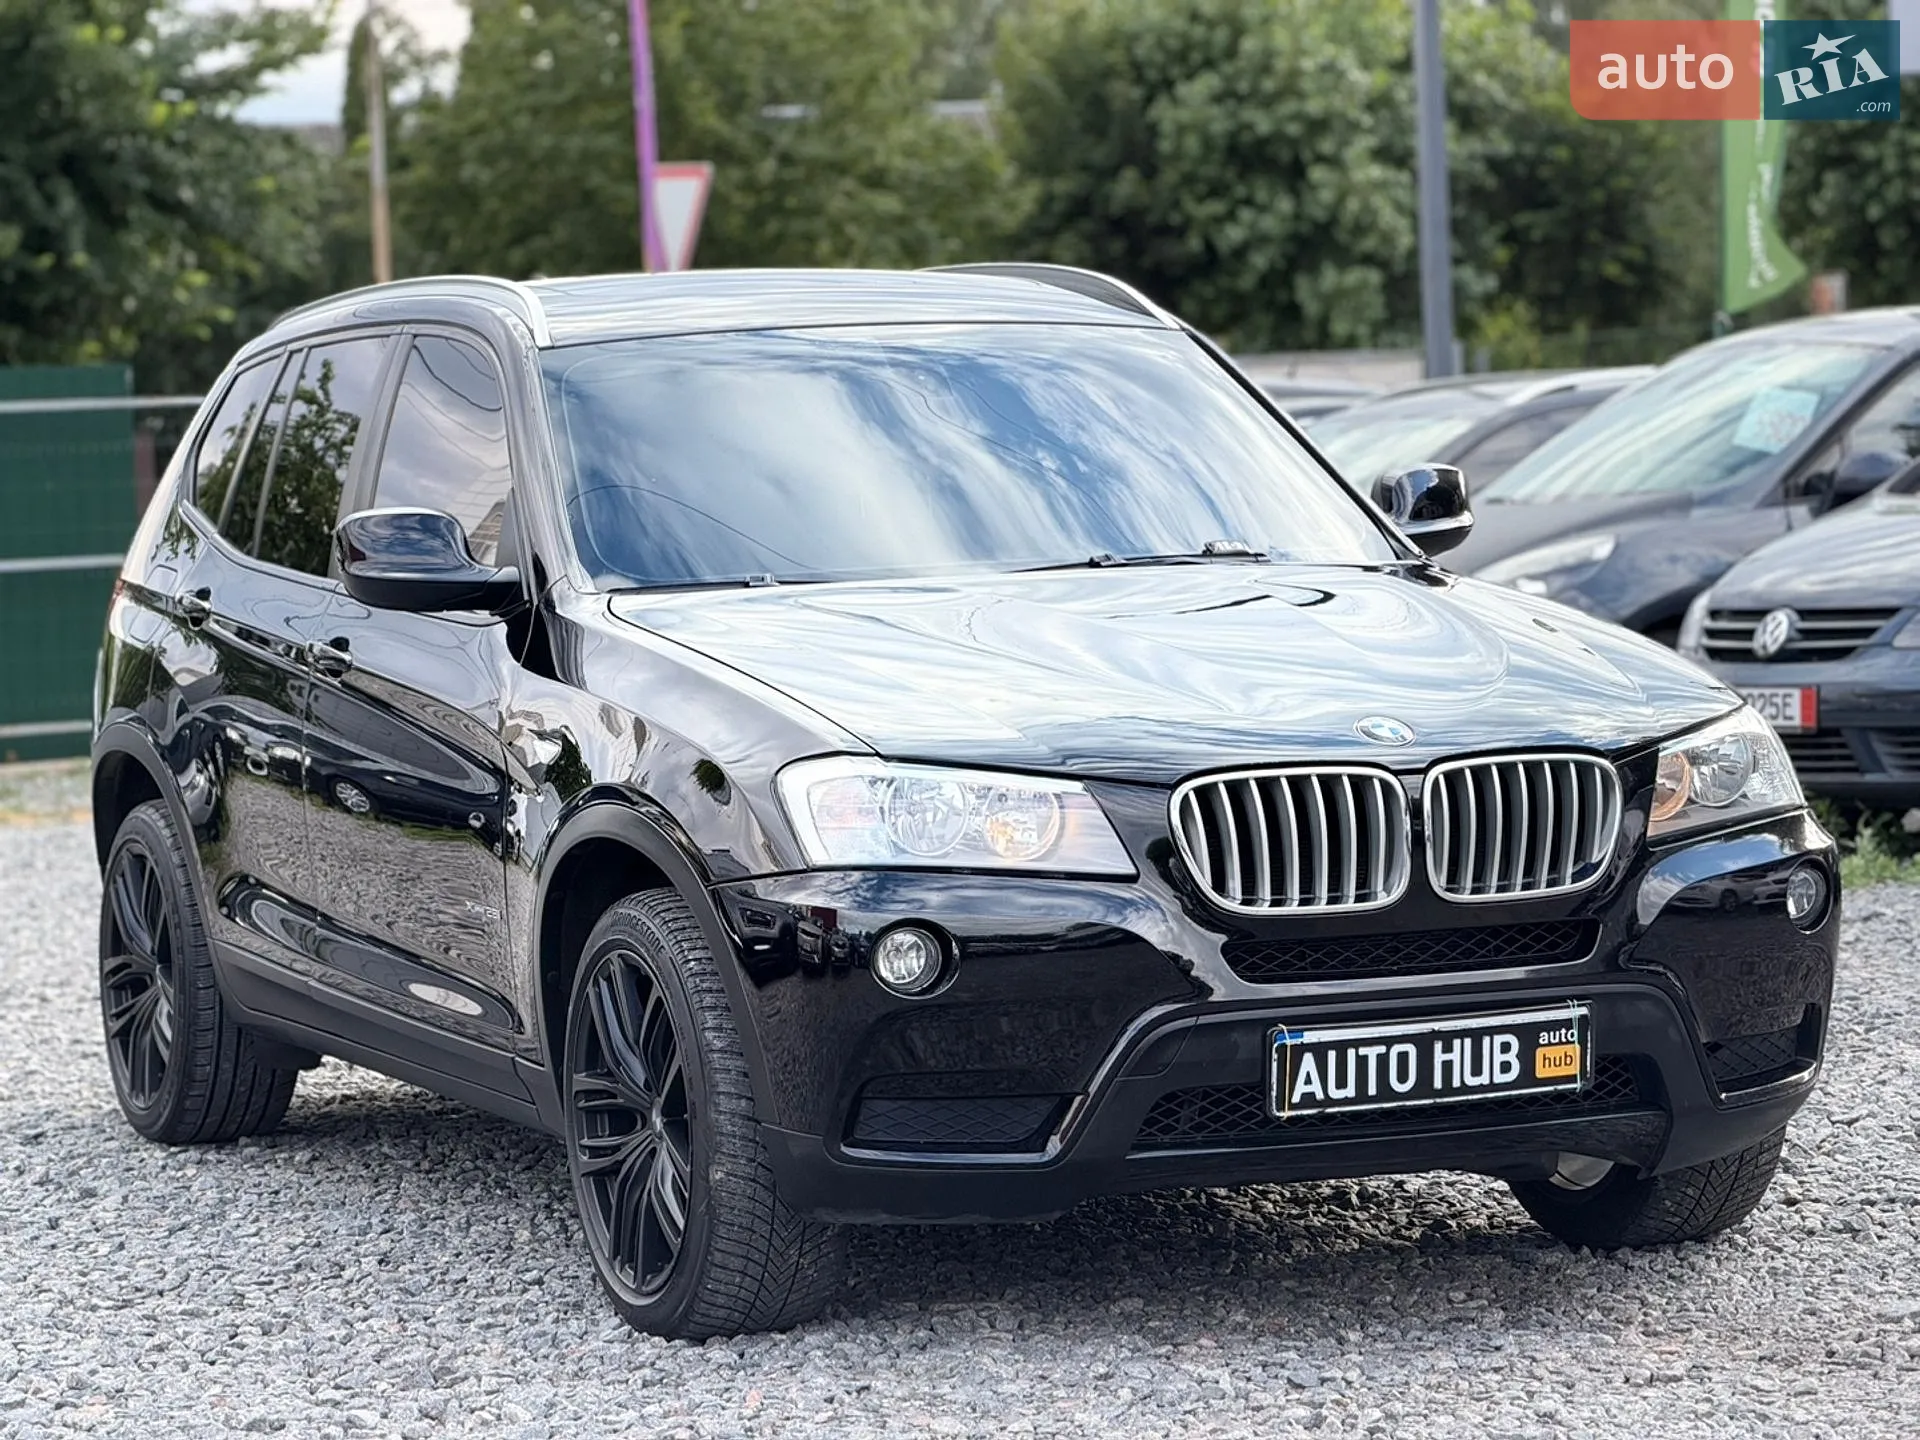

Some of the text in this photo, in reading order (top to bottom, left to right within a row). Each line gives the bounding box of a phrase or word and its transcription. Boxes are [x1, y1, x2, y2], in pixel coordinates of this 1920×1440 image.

[1538, 1027, 1577, 1045] auto
[1291, 1034, 1521, 1104] AUTO HUB
[1542, 1051, 1573, 1069] hub
